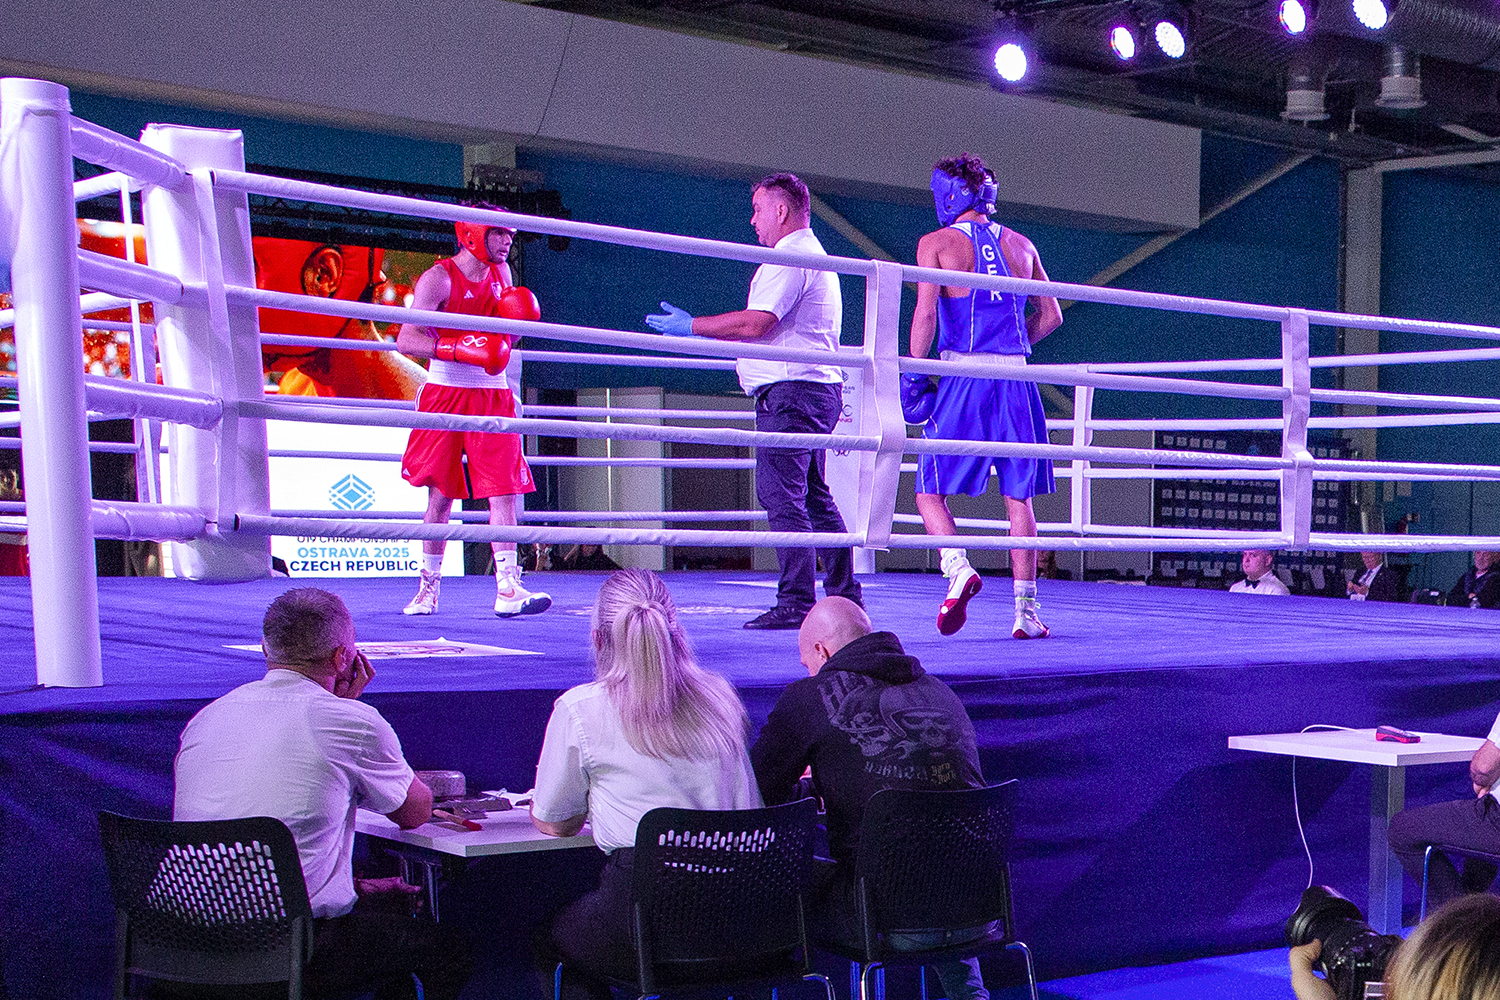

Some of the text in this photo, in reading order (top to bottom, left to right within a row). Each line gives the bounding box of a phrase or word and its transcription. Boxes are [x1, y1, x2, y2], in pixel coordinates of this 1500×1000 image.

[297, 547, 410, 558] OSTRAVA 2025
[289, 560, 418, 572] CZECH REPUBLIC
